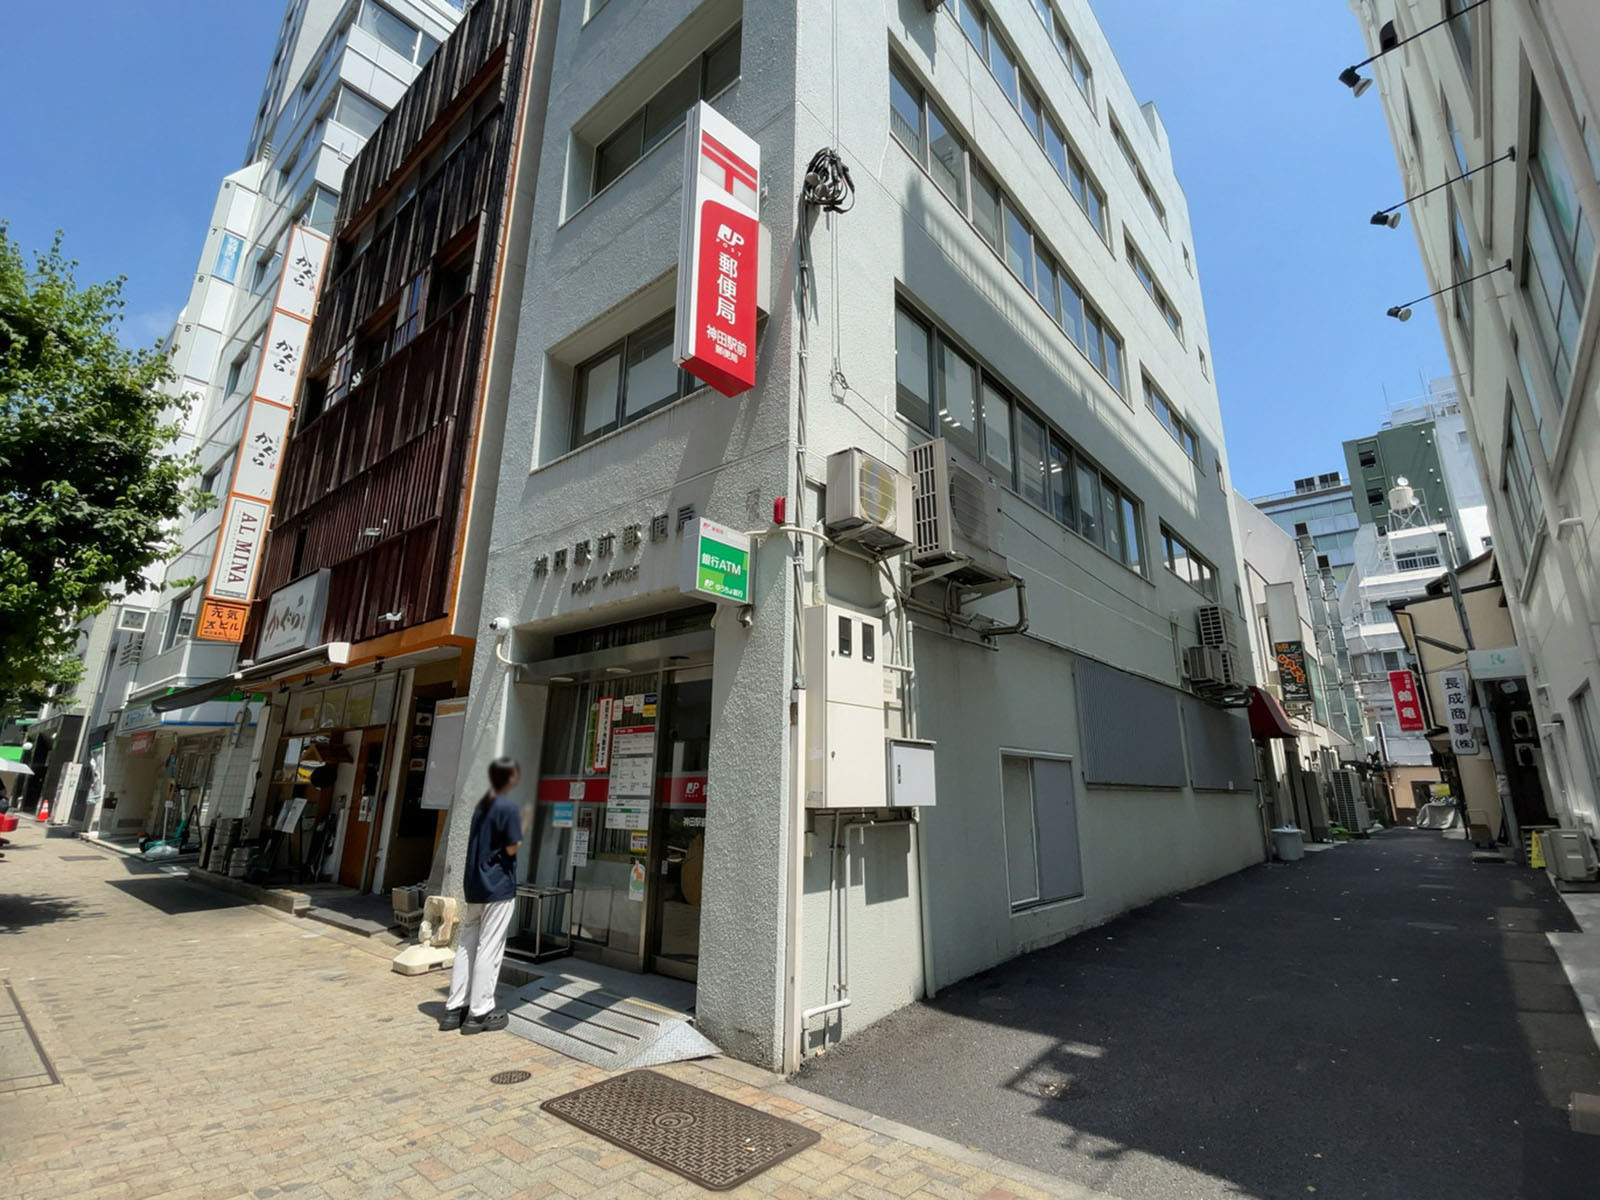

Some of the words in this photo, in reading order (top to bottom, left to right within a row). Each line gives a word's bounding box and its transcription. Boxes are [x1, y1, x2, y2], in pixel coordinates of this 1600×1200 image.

[211, 228, 218, 236] 7
[717, 223, 745, 247] JP
[716, 238, 742, 258] POST
[197, 275, 205, 283] 6
[716, 251, 739, 325] 郵便局
[184, 325, 191, 333] 5
[705, 323, 748, 359] 神田駅前
[240, 512, 258, 535] AL
[533, 503, 695, 580] 神田駅前郵便局
[227, 539, 253, 585] MINA
[701, 552, 742, 576] 銀行ATM
[601, 563, 641, 587] OFFICE
[1277, 653, 1305, 684] GAME
[1444, 677, 1475, 749] 長成商事(株)
